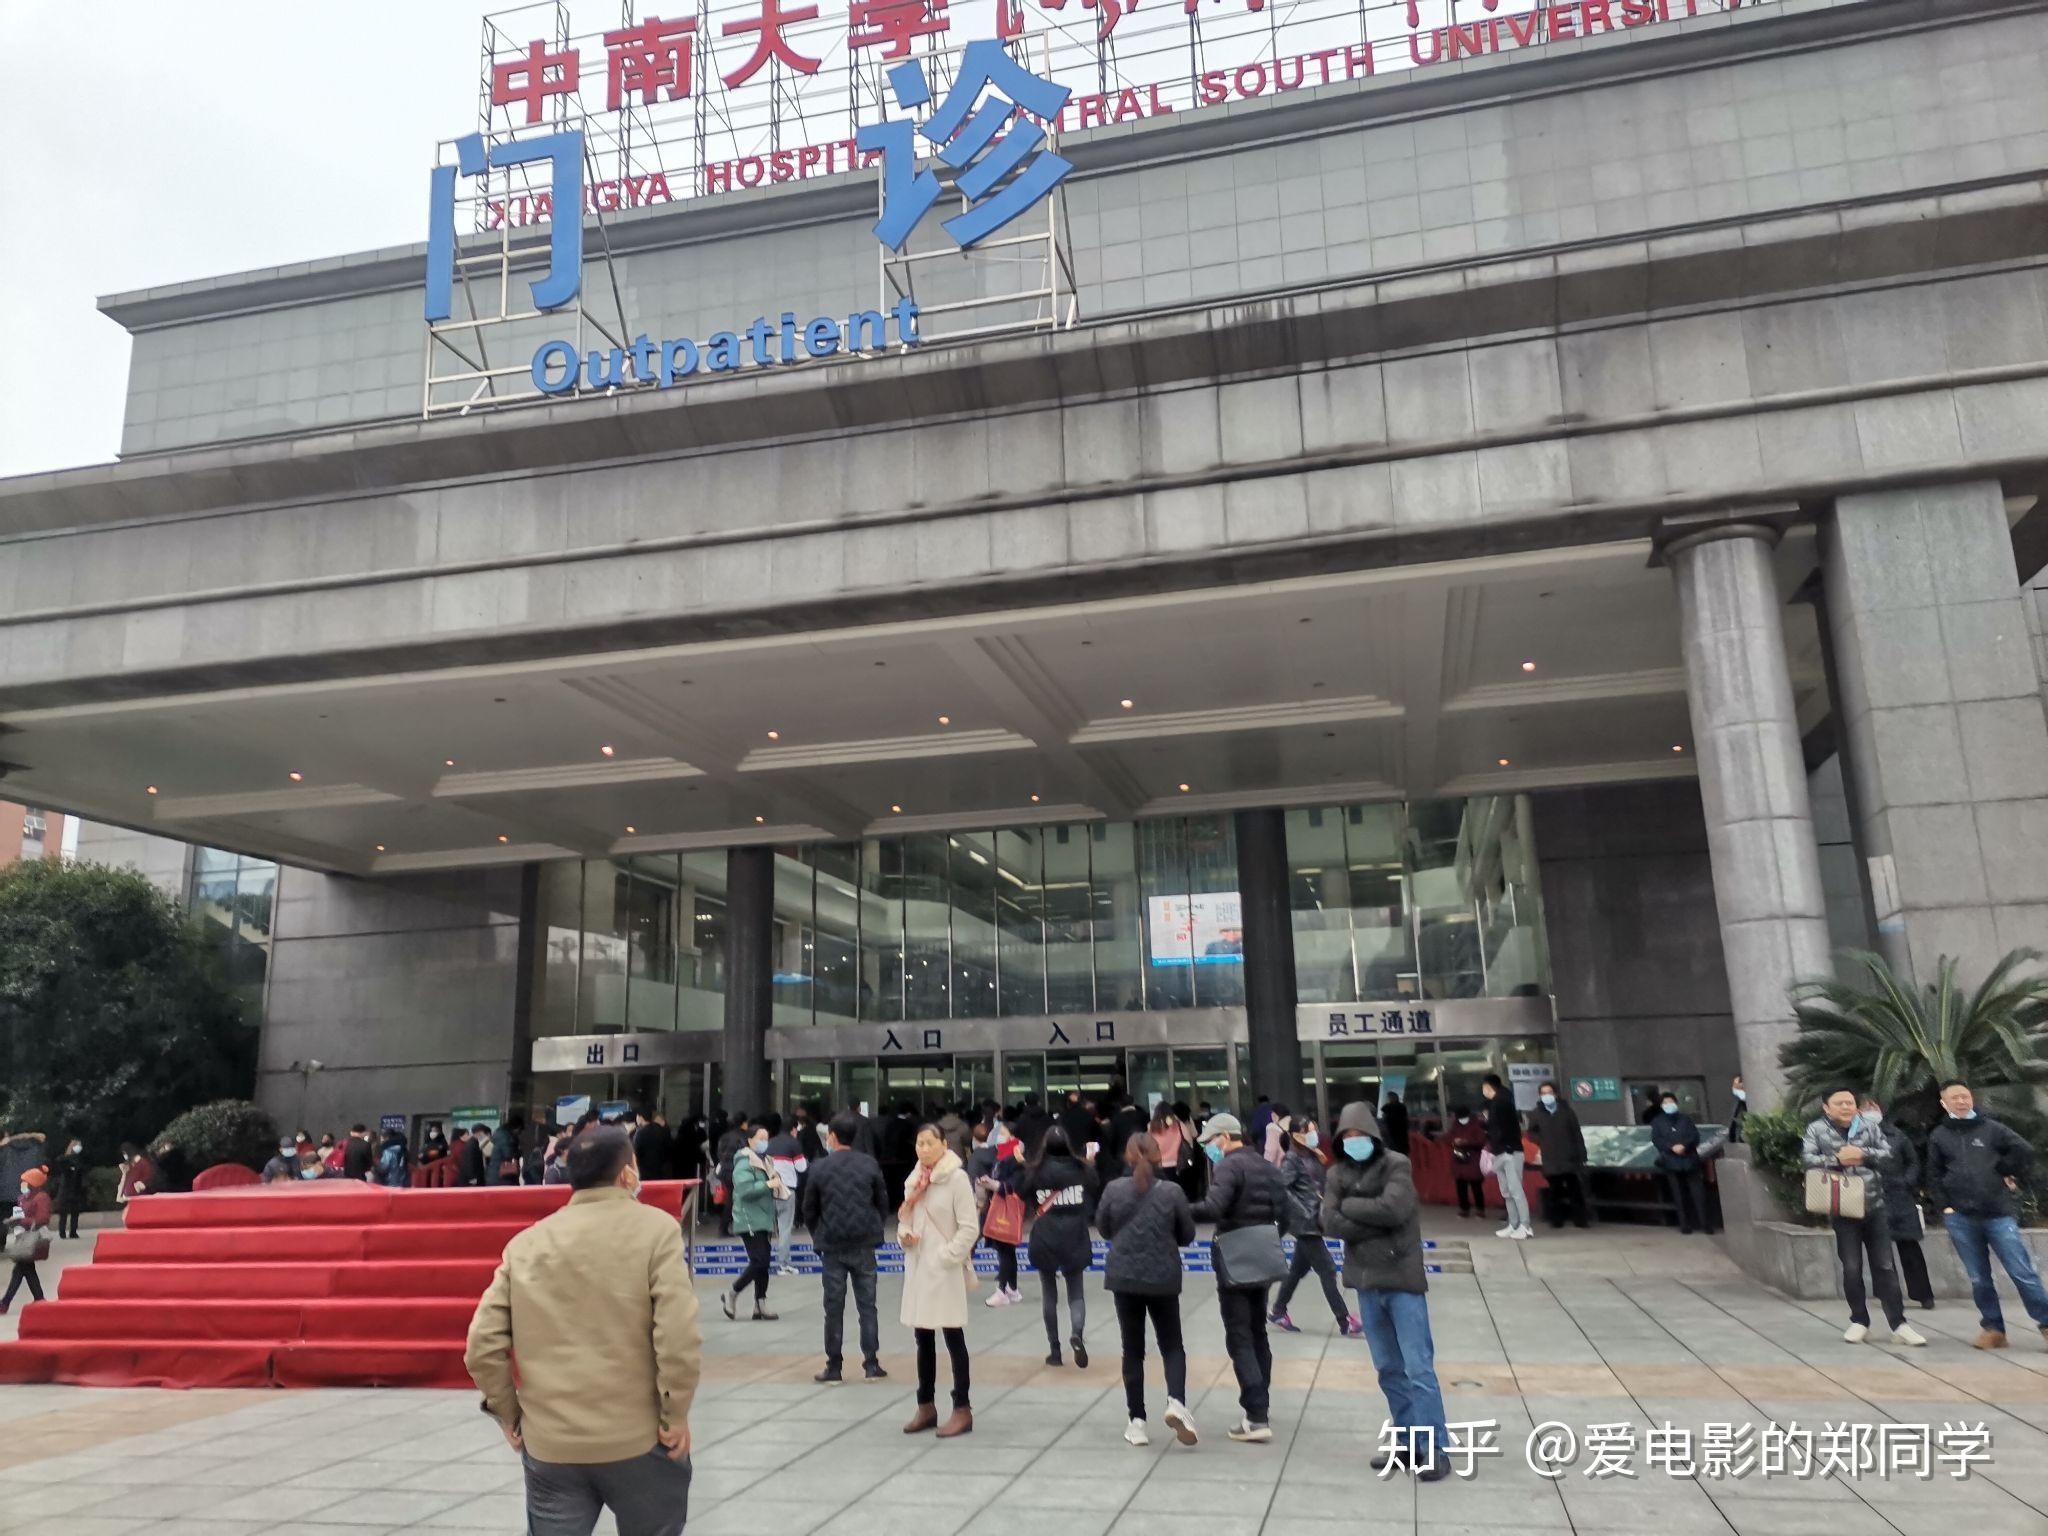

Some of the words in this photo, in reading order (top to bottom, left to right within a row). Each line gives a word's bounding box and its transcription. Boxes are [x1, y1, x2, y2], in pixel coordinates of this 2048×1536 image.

[488, 172, 673, 230] XIAGYA
[1200, 41, 1375, 104] SOUTH
[1408, 0, 1740, 66] UNIVERSI
[425, 38, 1074, 322] 门诊
[531, 297, 919, 394] Outpatient
[1049, 1021, 1115, 1045] 入口
[1329, 1009, 1432, 1036] 员工通道
[882, 1029, 942, 1051] 入口
[587, 1043, 639, 1065] 出口
